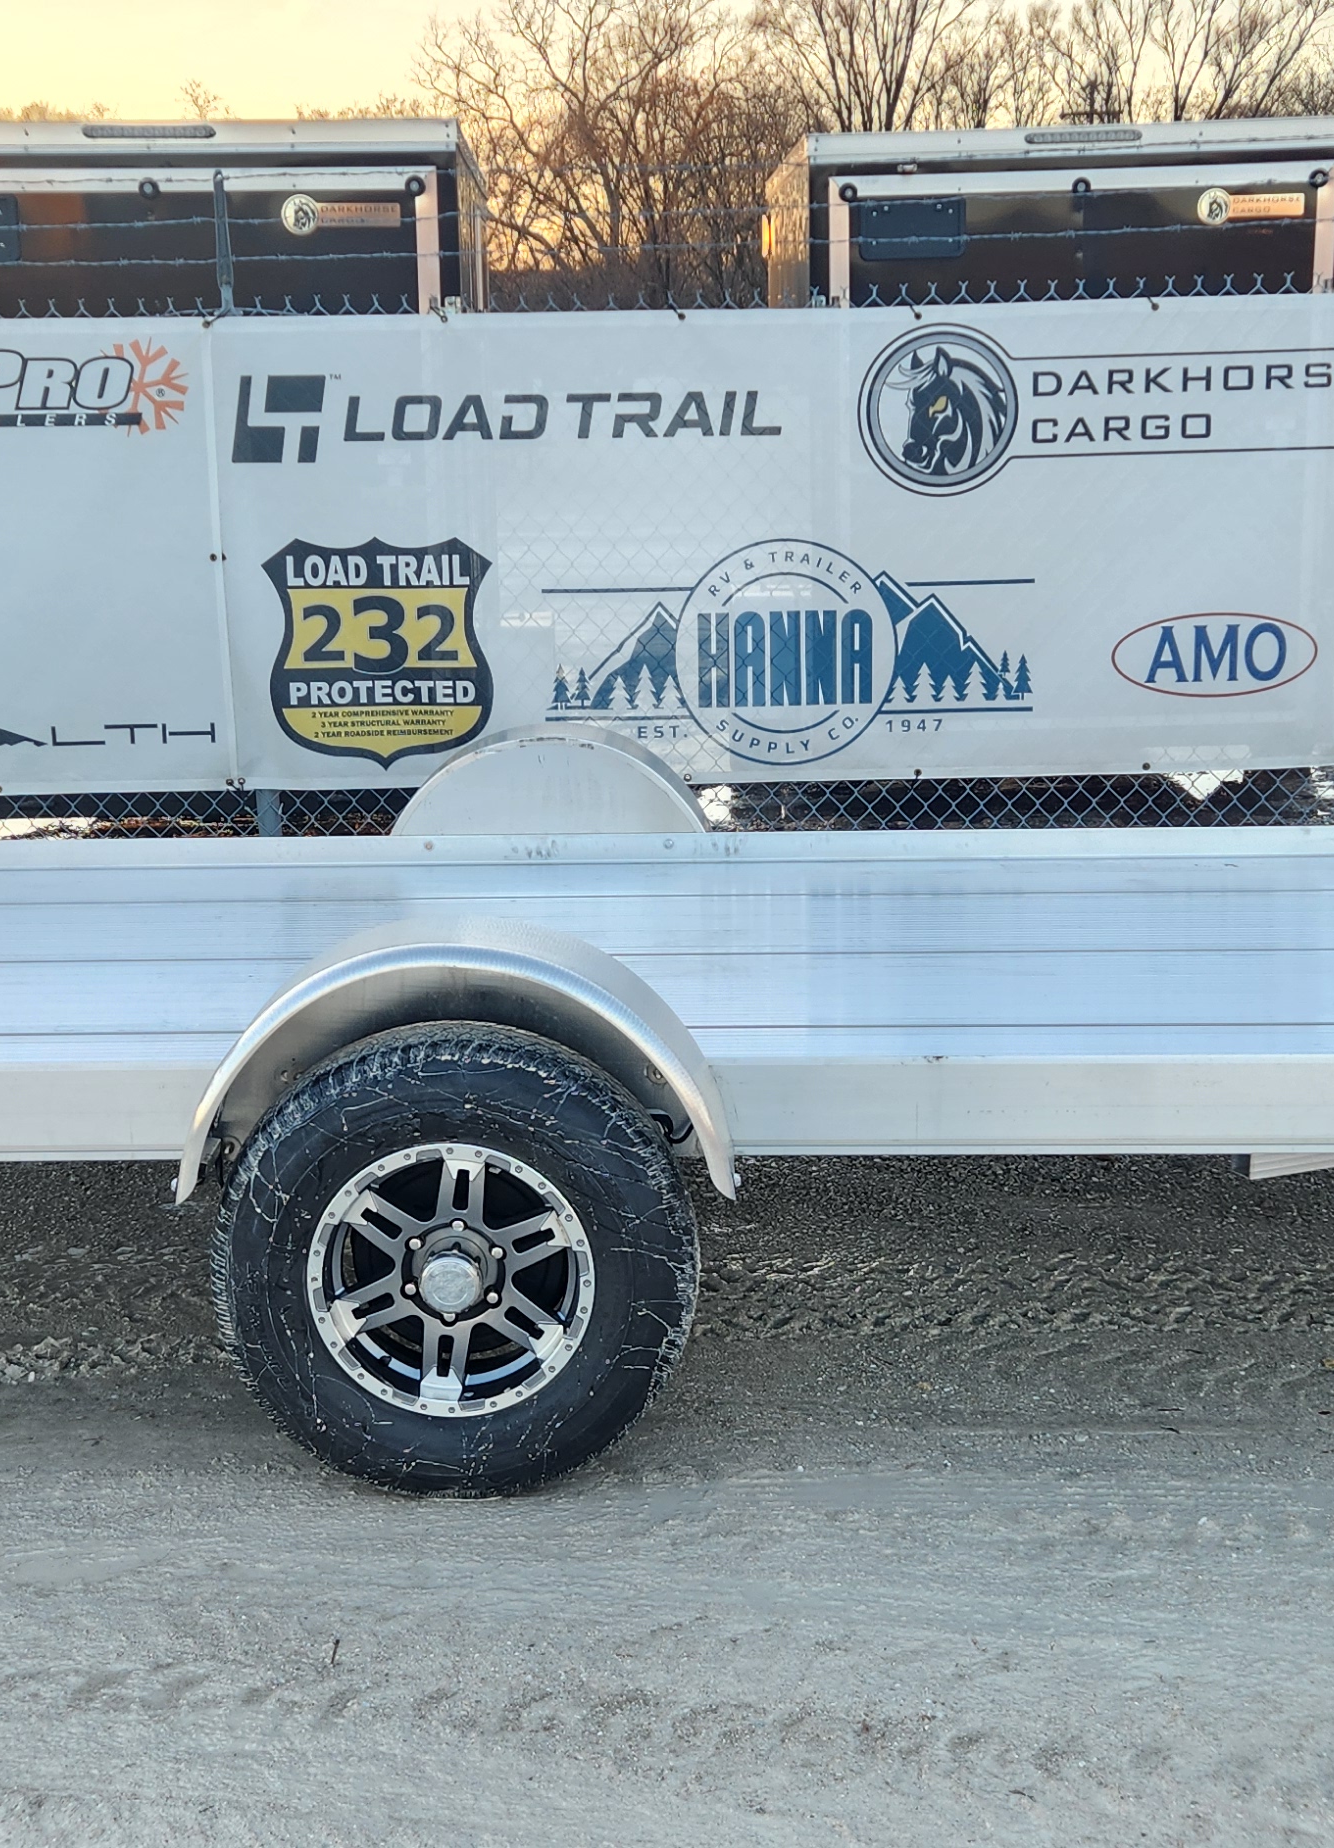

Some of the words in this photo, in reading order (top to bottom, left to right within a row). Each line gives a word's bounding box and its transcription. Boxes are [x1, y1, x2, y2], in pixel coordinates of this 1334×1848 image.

[320, 205, 398, 213] DARKHORSE
[343, 394, 549, 442] LOAD
[566, 390, 782, 439] TRAIL
[1031, 413, 1212, 444] CARGO
[285, 554, 367, 587] LOAD
[376, 554, 470, 586] TRAIL
[707, 571, 733, 598] RV
[743, 558, 755, 571] &
[768, 550, 862, 595] TRAILER
[302, 595, 459, 675] 232
[697, 608, 873, 709] HANNA
[1144, 622, 1287, 684] AMO
[289, 679, 476, 705] PROTECTED
[327, 720, 348, 728] YEAR
[341, 709, 410, 717] COMPREHENSIVE
[885, 718, 944, 733] 1947
[321, 730, 342, 738] YEAR
[637, 724, 688, 739] EST.
[716, 718, 813, 755] SUPPLY
[827, 716, 860, 742] CO.
